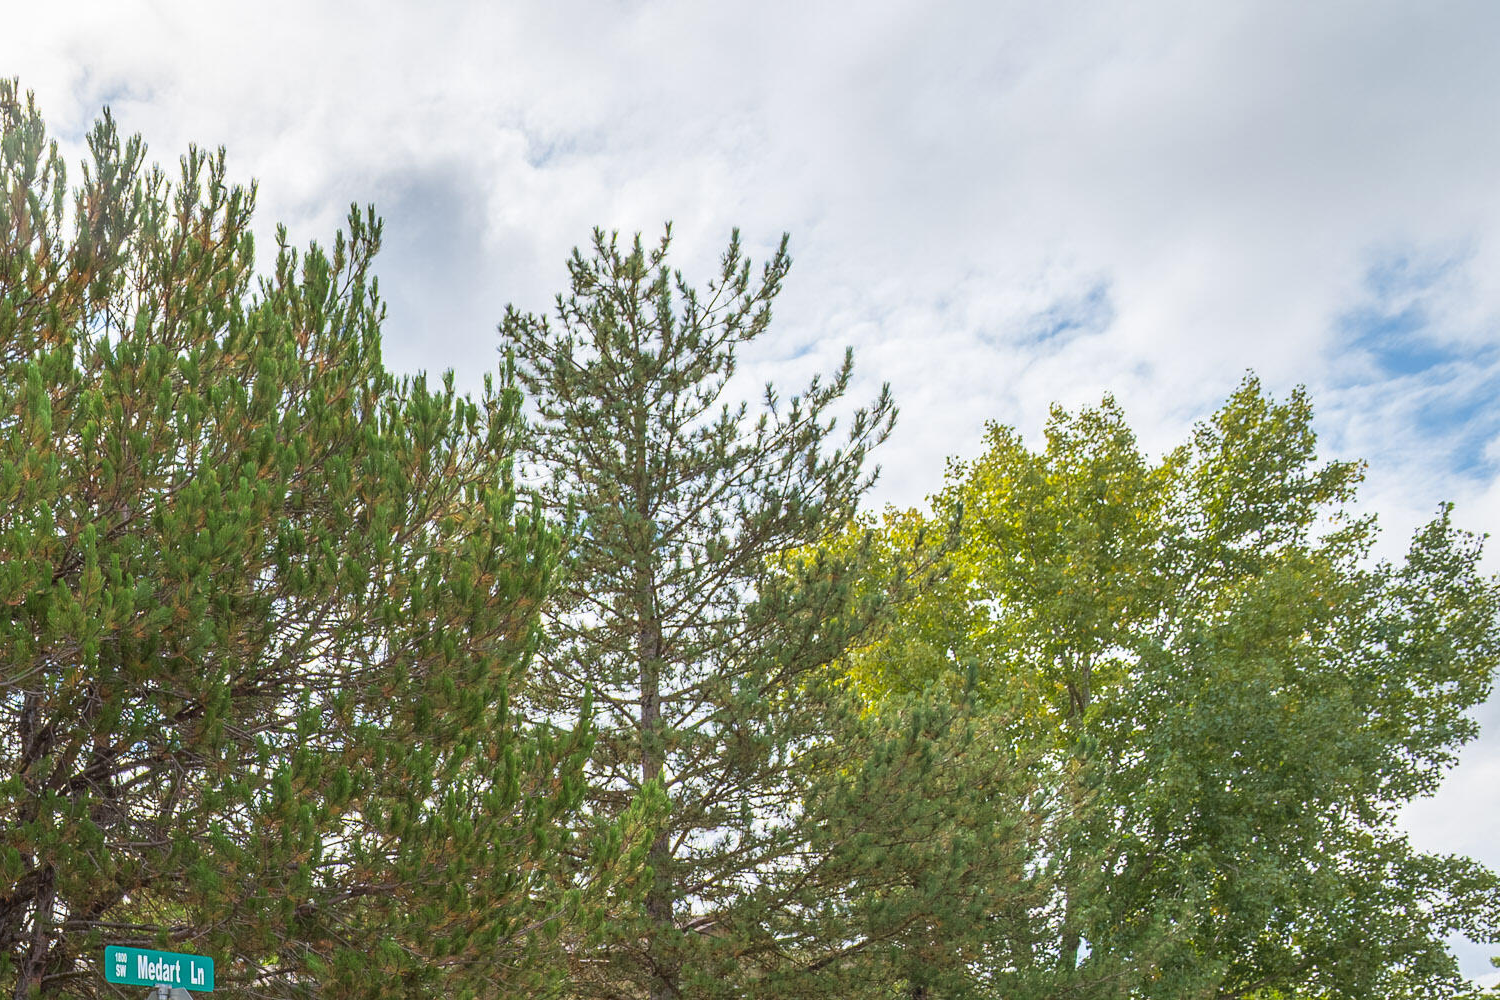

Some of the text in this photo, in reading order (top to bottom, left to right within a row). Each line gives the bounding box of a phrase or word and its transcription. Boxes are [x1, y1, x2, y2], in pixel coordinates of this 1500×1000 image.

[115, 964, 127, 977] SW
[137, 955, 205, 985] Medart Ln
